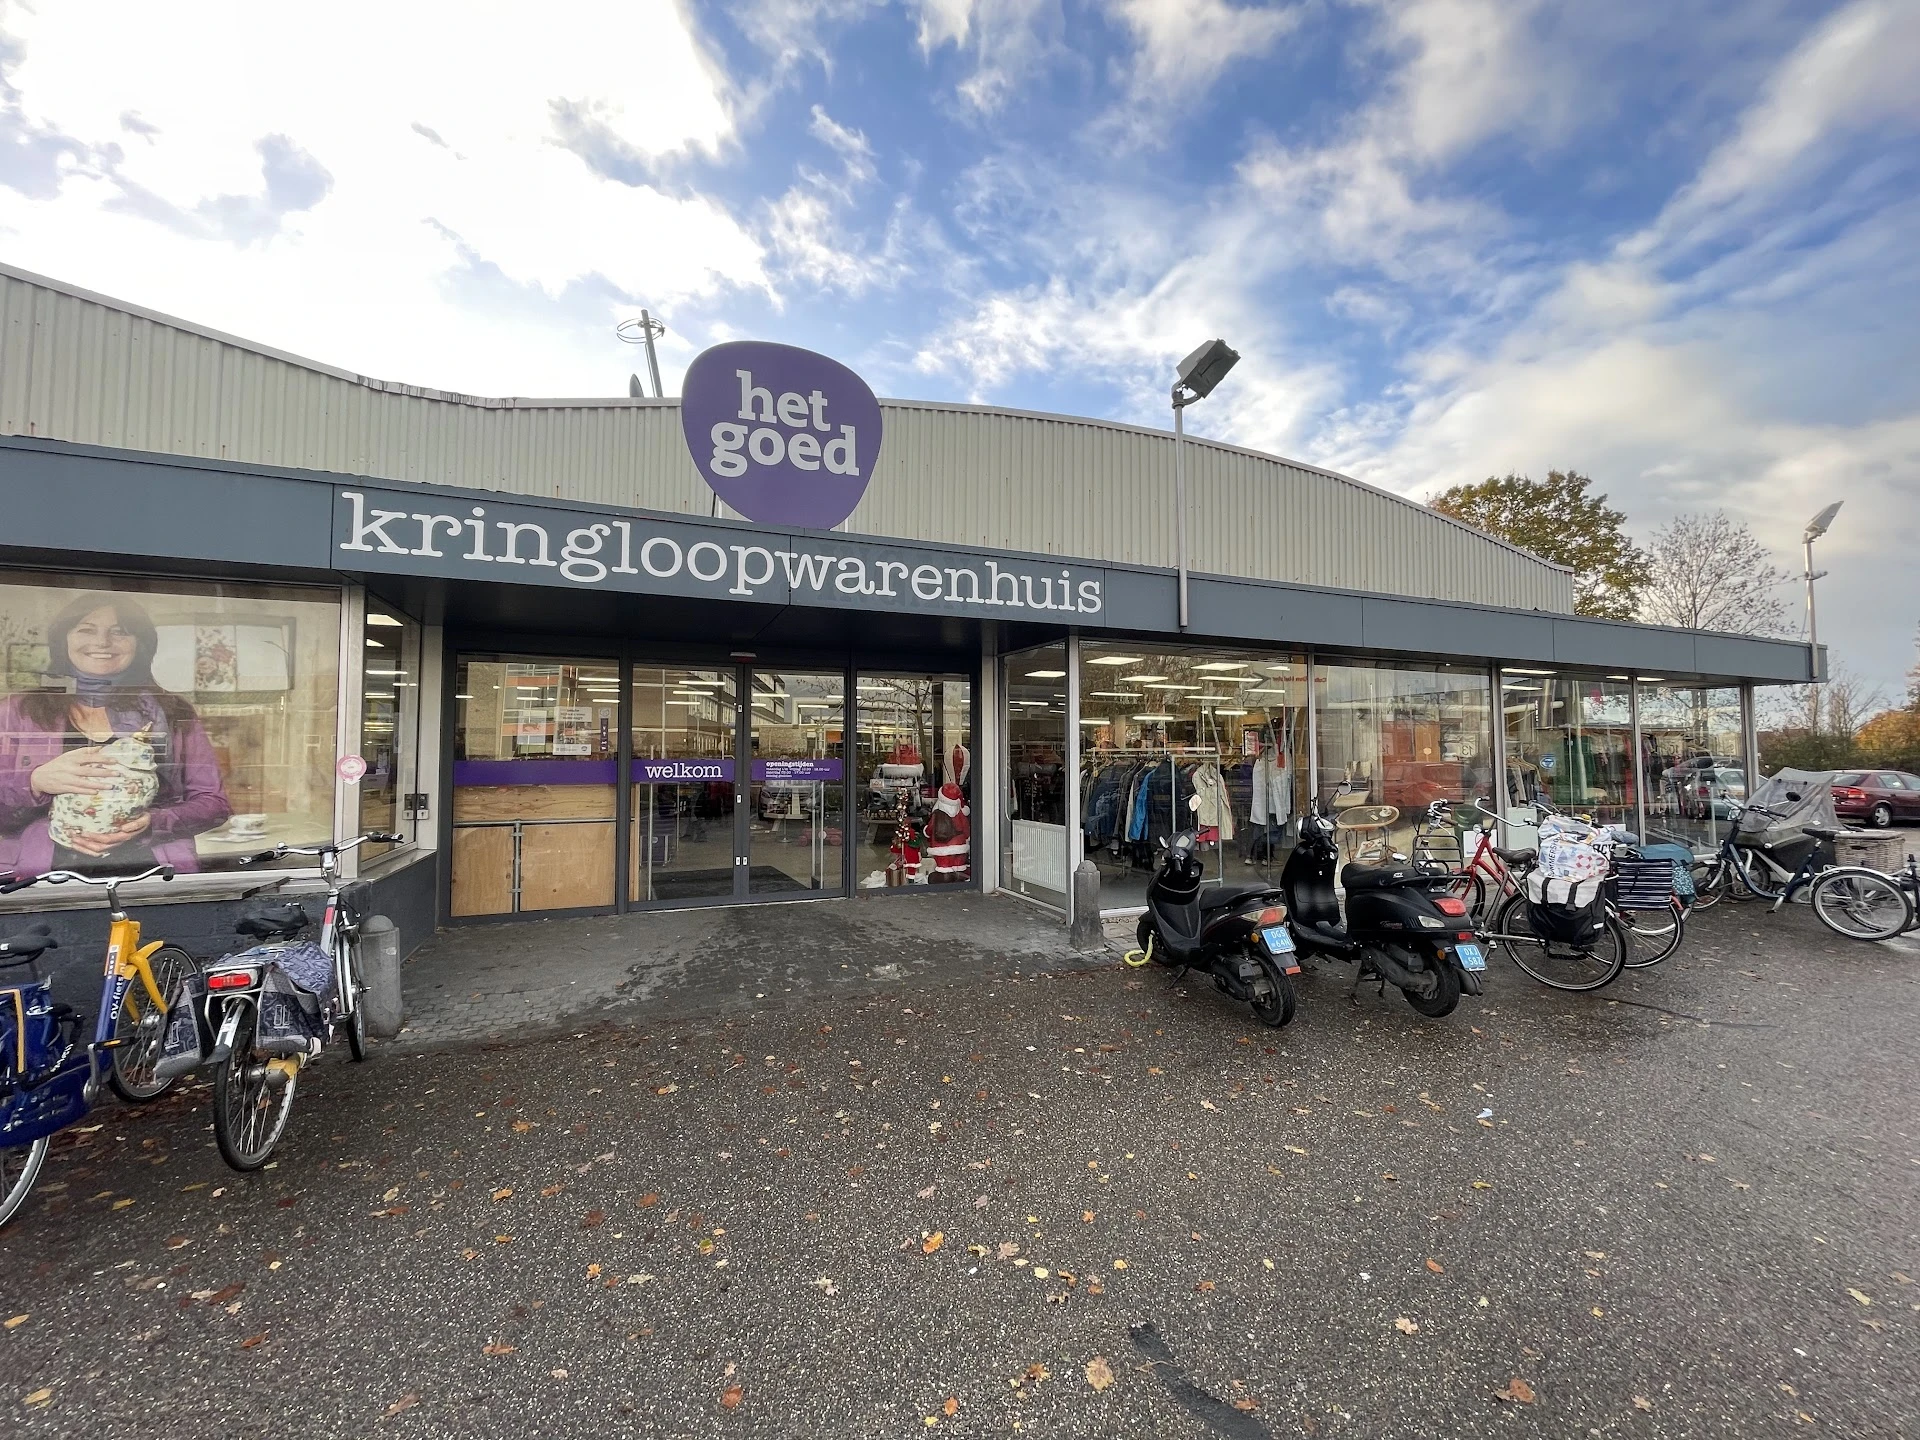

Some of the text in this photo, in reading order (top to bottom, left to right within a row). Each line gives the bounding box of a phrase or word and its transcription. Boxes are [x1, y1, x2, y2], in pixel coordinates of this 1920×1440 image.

[736, 369, 831, 432] het
[709, 421, 859, 477] goed
[339, 491, 1102, 614] kringloopwarenhuis
[645, 762, 723, 779] welkom
